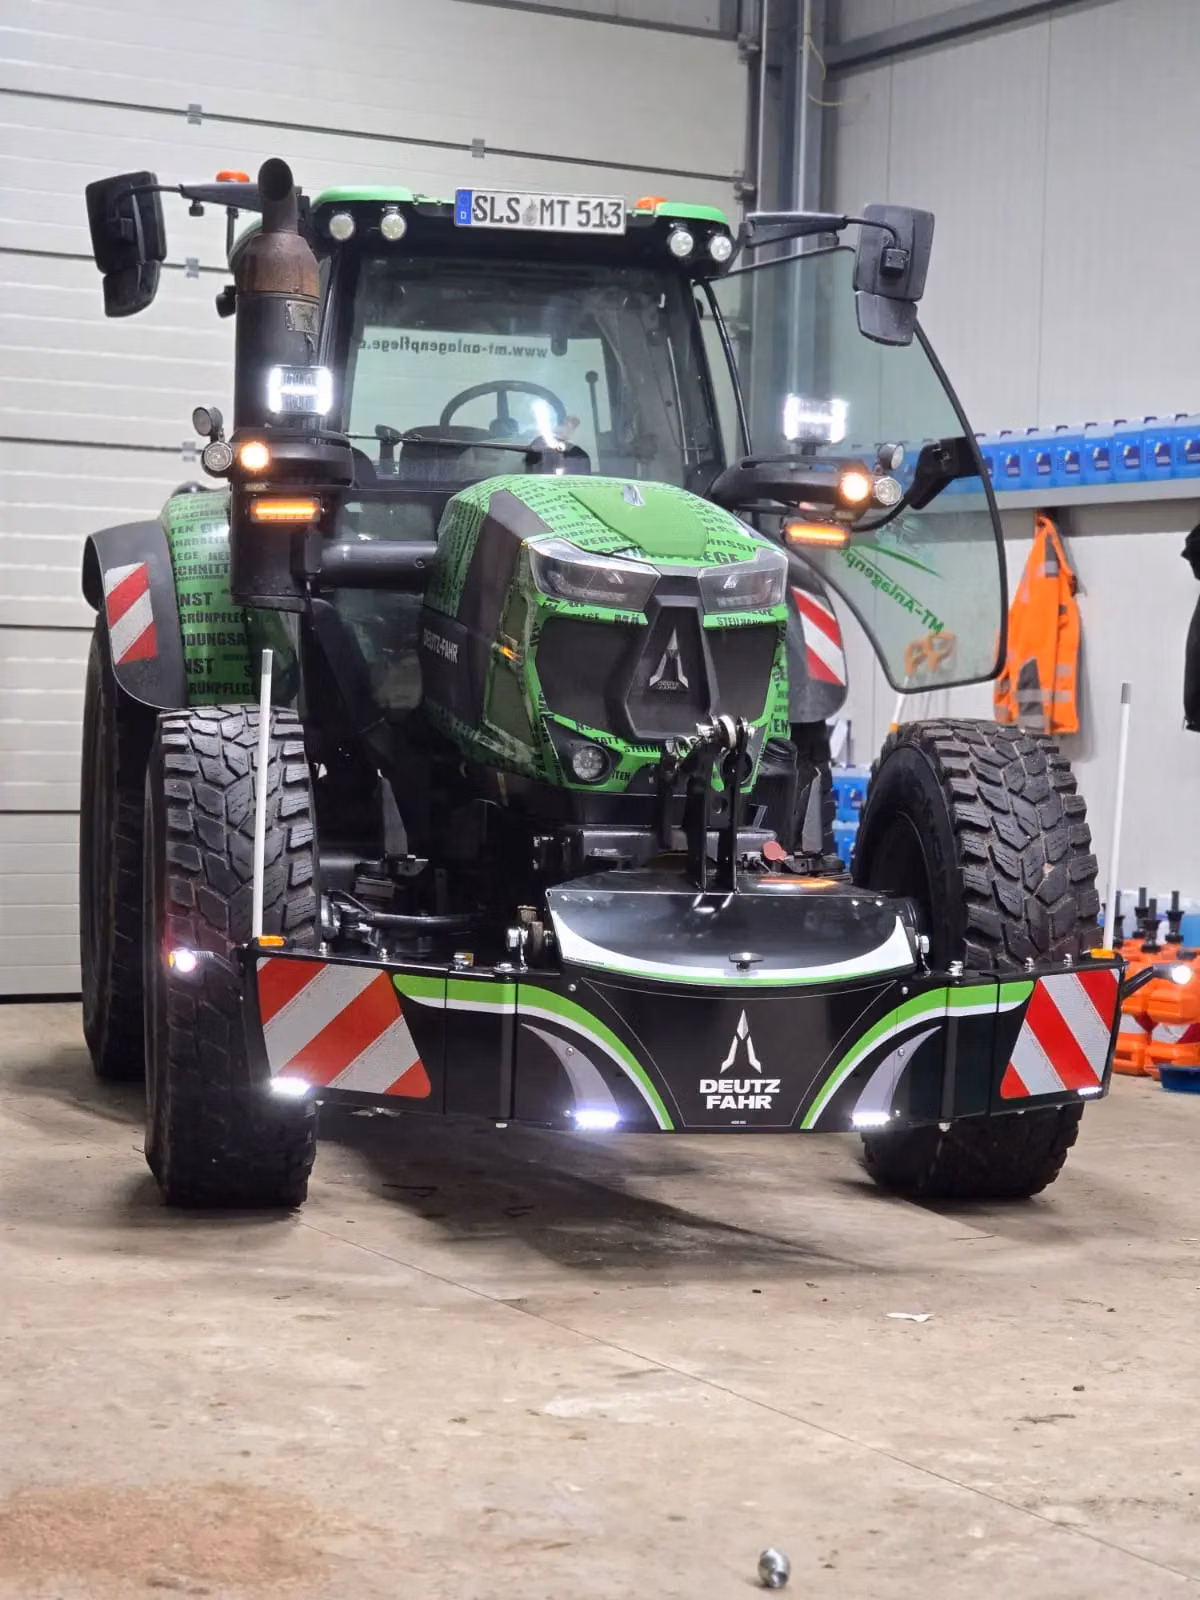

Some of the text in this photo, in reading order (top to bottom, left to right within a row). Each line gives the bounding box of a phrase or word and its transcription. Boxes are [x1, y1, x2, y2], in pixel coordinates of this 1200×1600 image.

[473, 195, 622, 228] SLS MT 513
[699, 1079, 781, 1094] DEUTZ
[706, 1095, 772, 1110] FAHR
